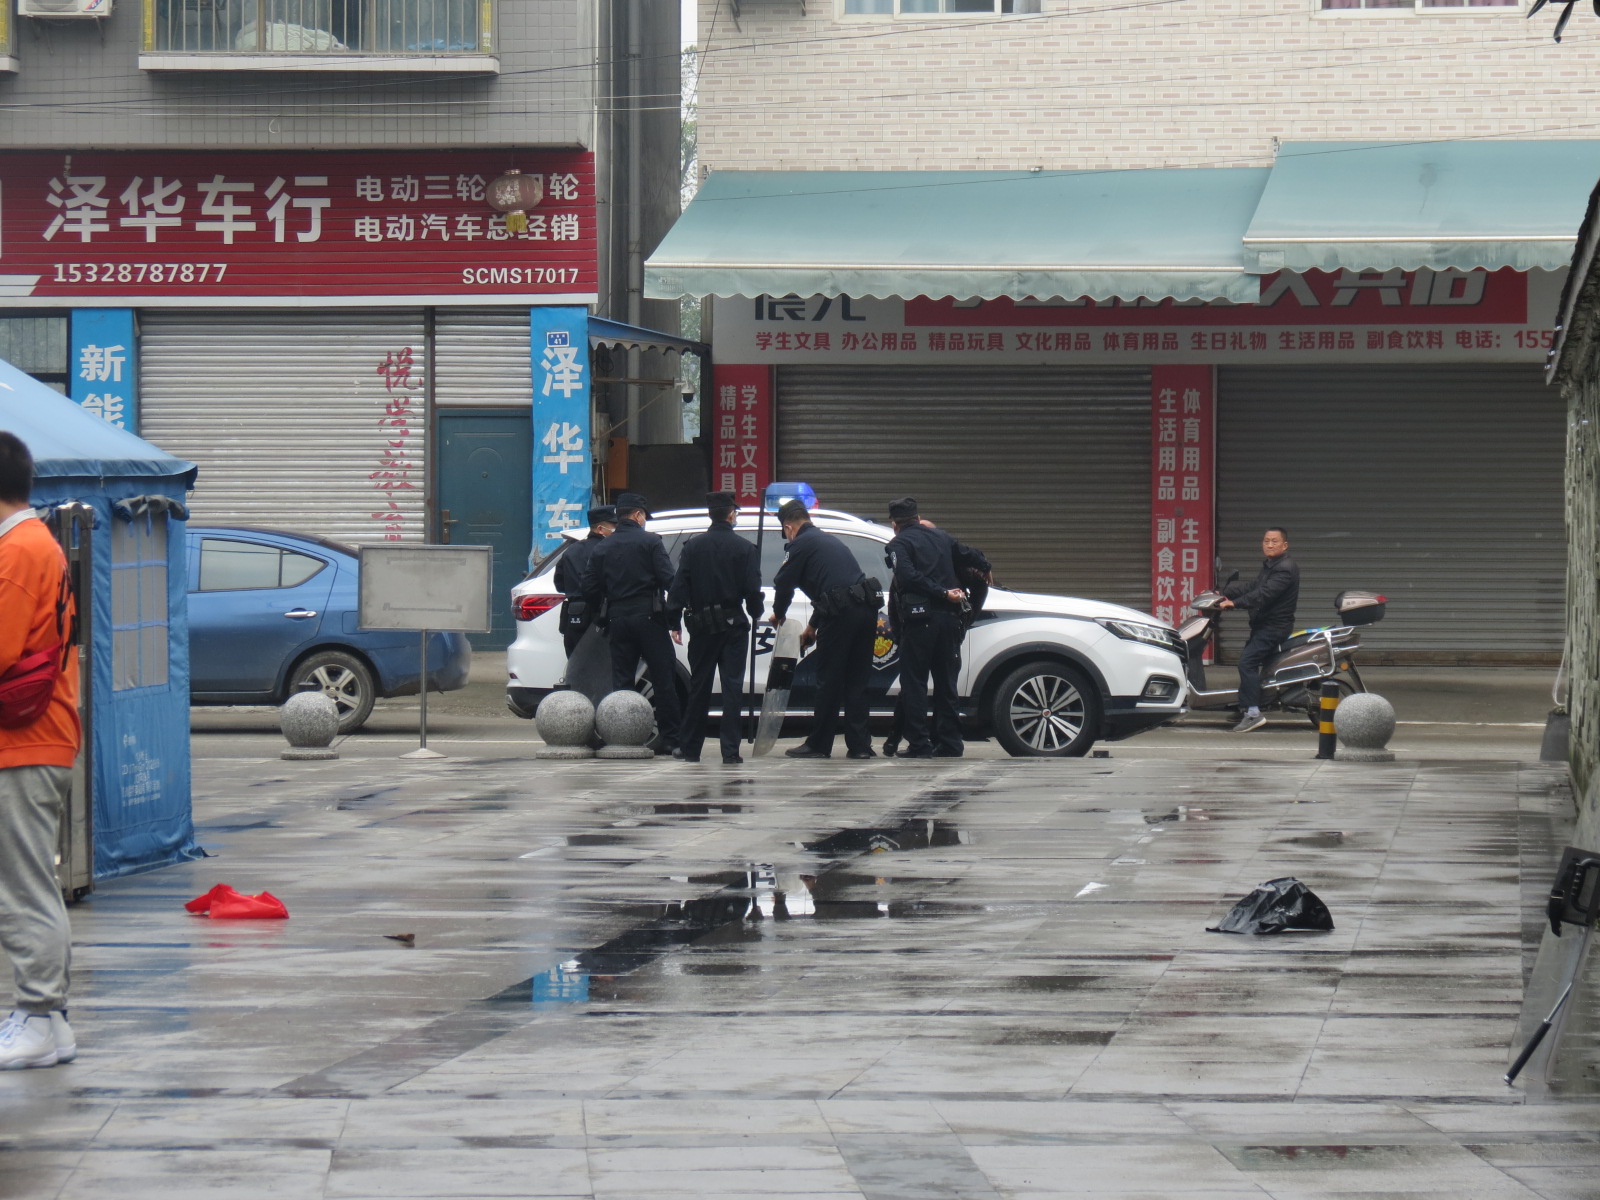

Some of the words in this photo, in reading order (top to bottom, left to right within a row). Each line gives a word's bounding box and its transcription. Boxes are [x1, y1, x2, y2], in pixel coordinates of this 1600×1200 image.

[42, 174, 331, 244] 泽华车行
[354, 213, 579, 242] 电动汽车总经销
[53, 263, 228, 283] 15328787877
[462, 267, 579, 284] SCMS17017
[756, 331, 831, 351] 学生文具
[841, 331, 917, 351] 办公用品
[928, 331, 1005, 351] 精品玩具
[1015, 331, 1092, 351] 文化用品
[1103, 331, 1179, 351] 体育用品
[1190, 331, 1267, 351] 生日礼物
[1279, 331, 1355, 351] 生活用品
[1367, 330, 1444, 350] 副食饮料
[541, 346, 584, 543] 泽华车
[720, 385, 737, 492] 精品玩具
[741, 385, 758, 498] 学生文具
[1158, 388, 1177, 500] 生活用品
[1182, 388, 1201, 500] 体育用品
